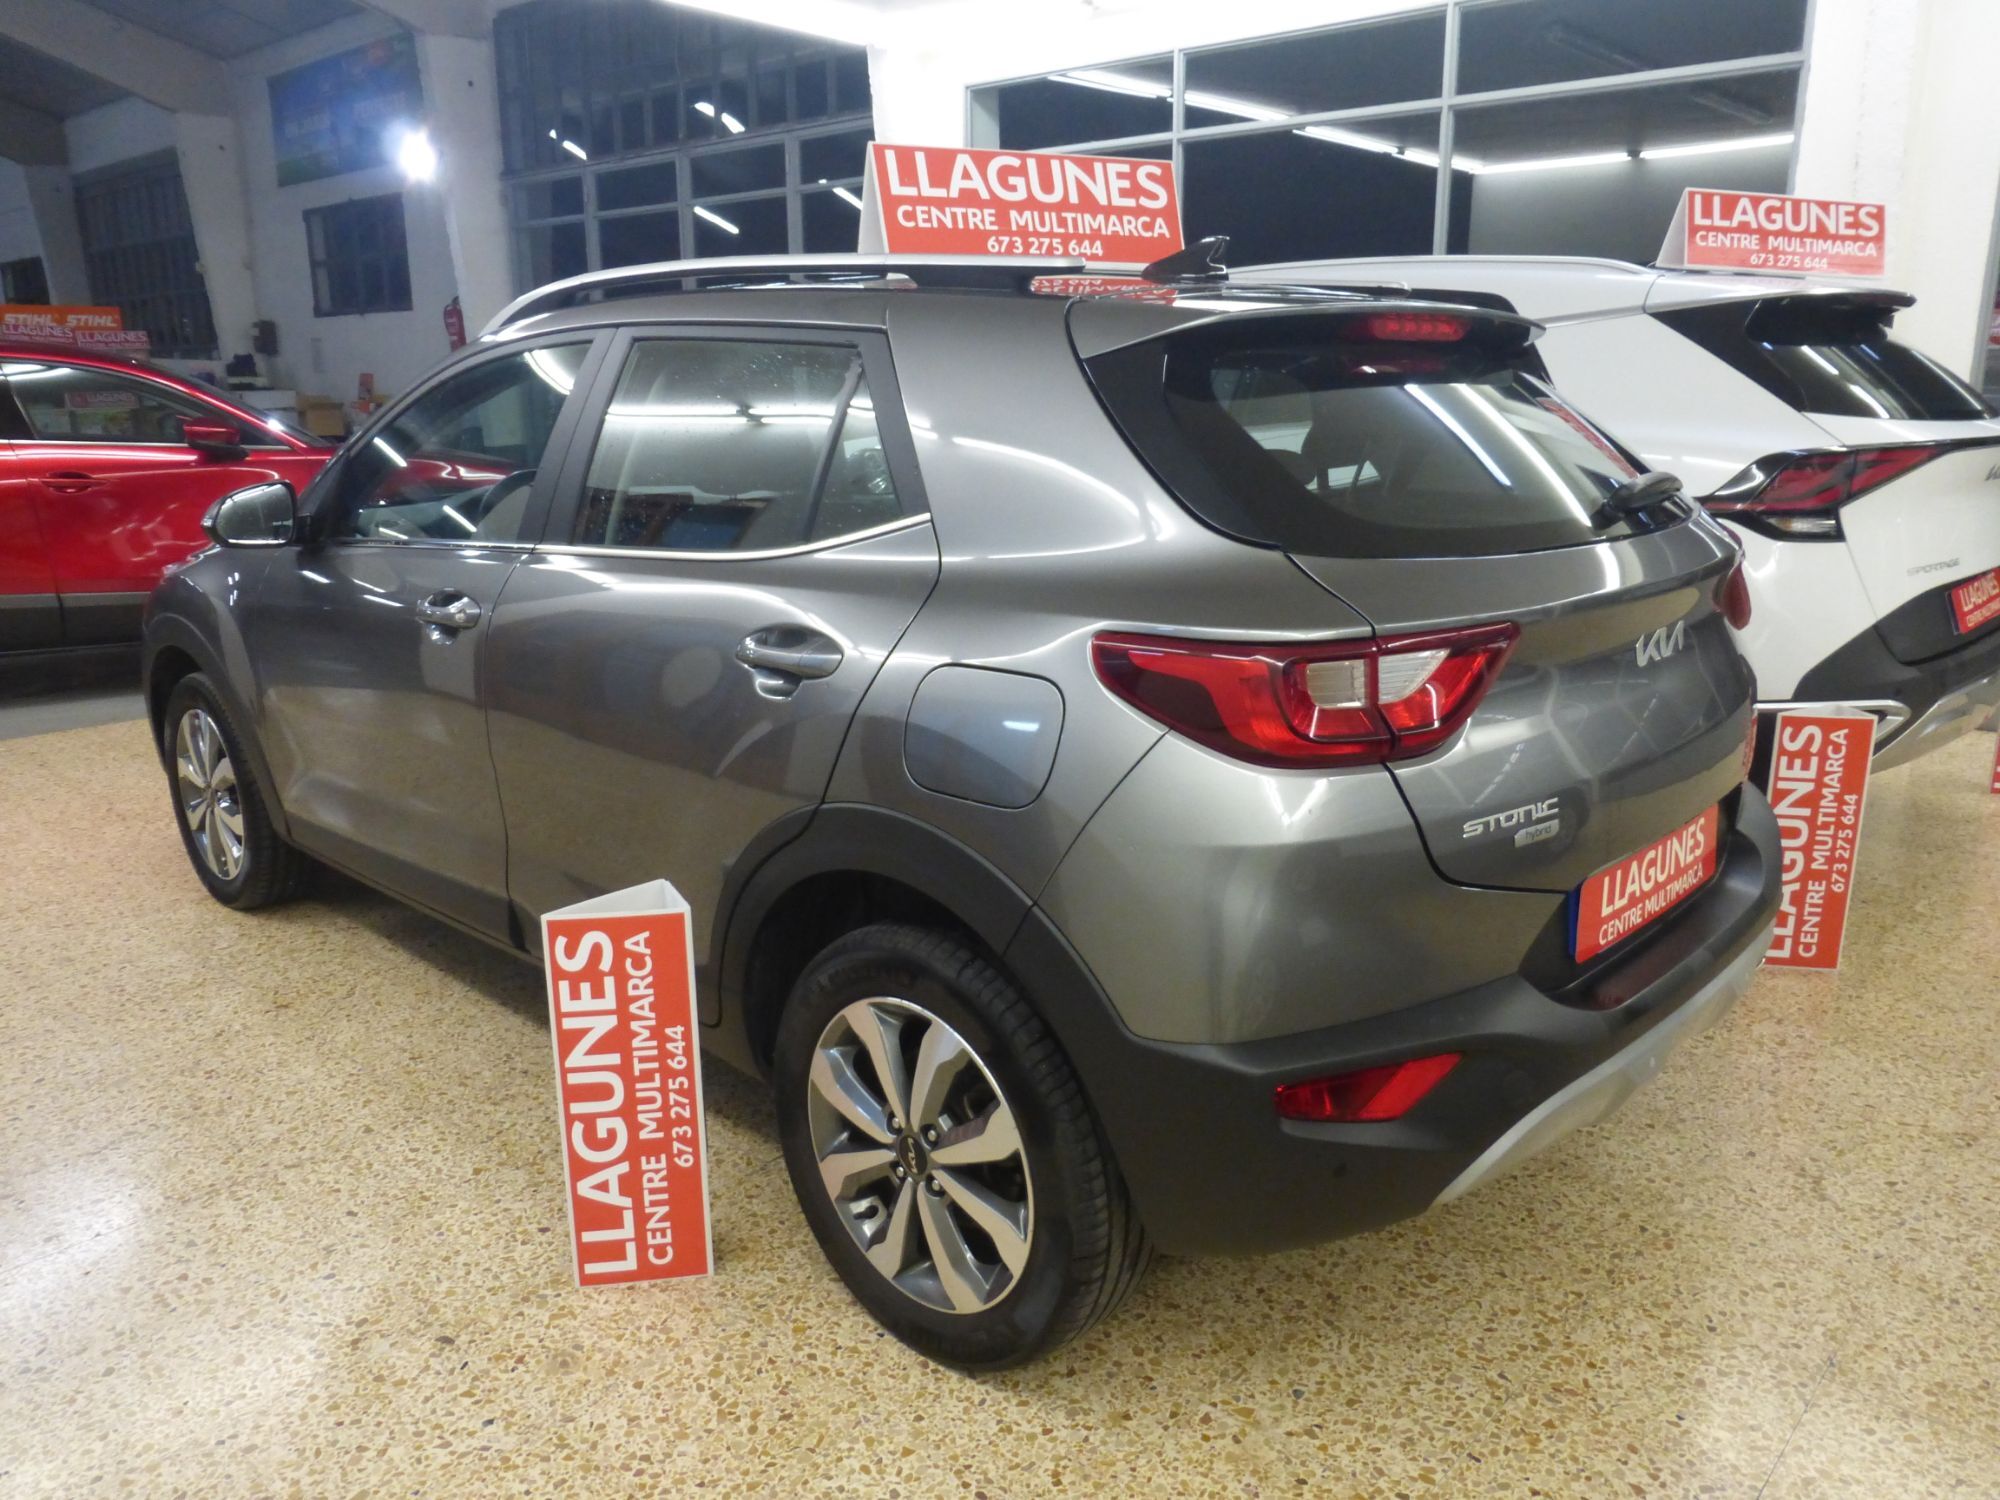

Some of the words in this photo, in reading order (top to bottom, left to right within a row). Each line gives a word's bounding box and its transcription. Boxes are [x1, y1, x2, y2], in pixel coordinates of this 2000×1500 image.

[884, 149, 1168, 209] LLAGUNES
[897, 205, 998, 231] CENTRE
[1009, 210, 1170, 238] MULTIMARCA
[1694, 194, 1879, 237] LLAGUNES
[987, 236, 1024, 254] 673
[1028, 237, 1063, 255] 275
[1068, 239, 1104, 257] 644
[1695, 231, 1760, 249] CENTRE
[1768, 236, 1877, 257] MULTIMARCA
[1750, 253, 1774, 265] 673
[1777, 254, 1800, 267] 275
[1803, 256, 1828, 269] 644
[2, 324, 73, 338] LLAGUNES
[4, 313, 56, 326] STIHL
[65, 314, 118, 327] STIHL
[78, 330, 148, 343] LLAGUNES
[1635, 620, 1685, 667] KIA
[1462, 797, 1560, 838] STONIC
[1811, 728, 1849, 870] MULTIMARCA
[1841, 794, 1859, 825] 644
[1525, 822, 1553, 842] hybrid
[1836, 828, 1854, 858] 275
[1601, 817, 1705, 918] LLAGUNES
[1831, 863, 1849, 893] 673
[1598, 903, 1643, 945] CENTRE
[1644, 861, 1703, 919] MULTIMARCA
[1798, 880, 1827, 958] CENTRE
[624, 931, 664, 1140] MULTIMARCA
[664, 1025, 688, 1070] 644
[555, 930, 638, 1275] LLAGUNES
[668, 1076, 691, 1120] 275
[672, 1125, 694, 1168] 673
[641, 1153, 673, 1265] CENTRE
